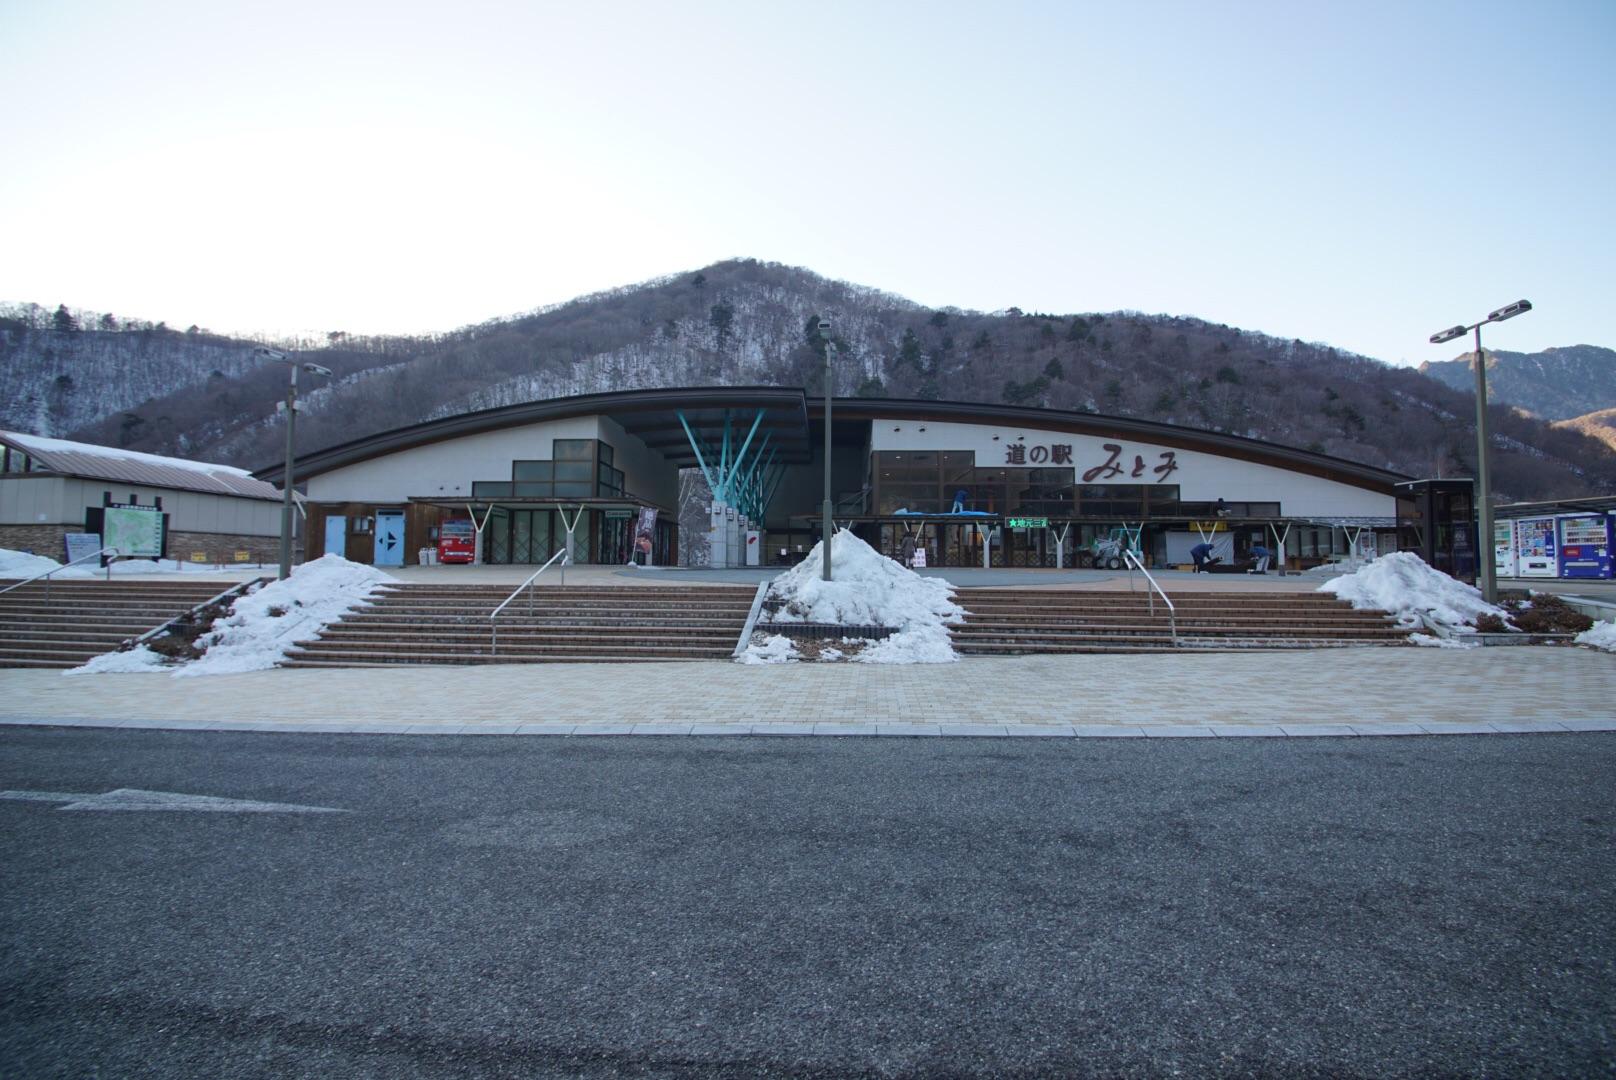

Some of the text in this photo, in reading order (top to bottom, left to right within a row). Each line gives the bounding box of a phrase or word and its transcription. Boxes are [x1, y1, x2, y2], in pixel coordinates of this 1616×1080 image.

[1005, 444, 1073, 465] 道の駅
[1082, 443, 1178, 483] みとみ
